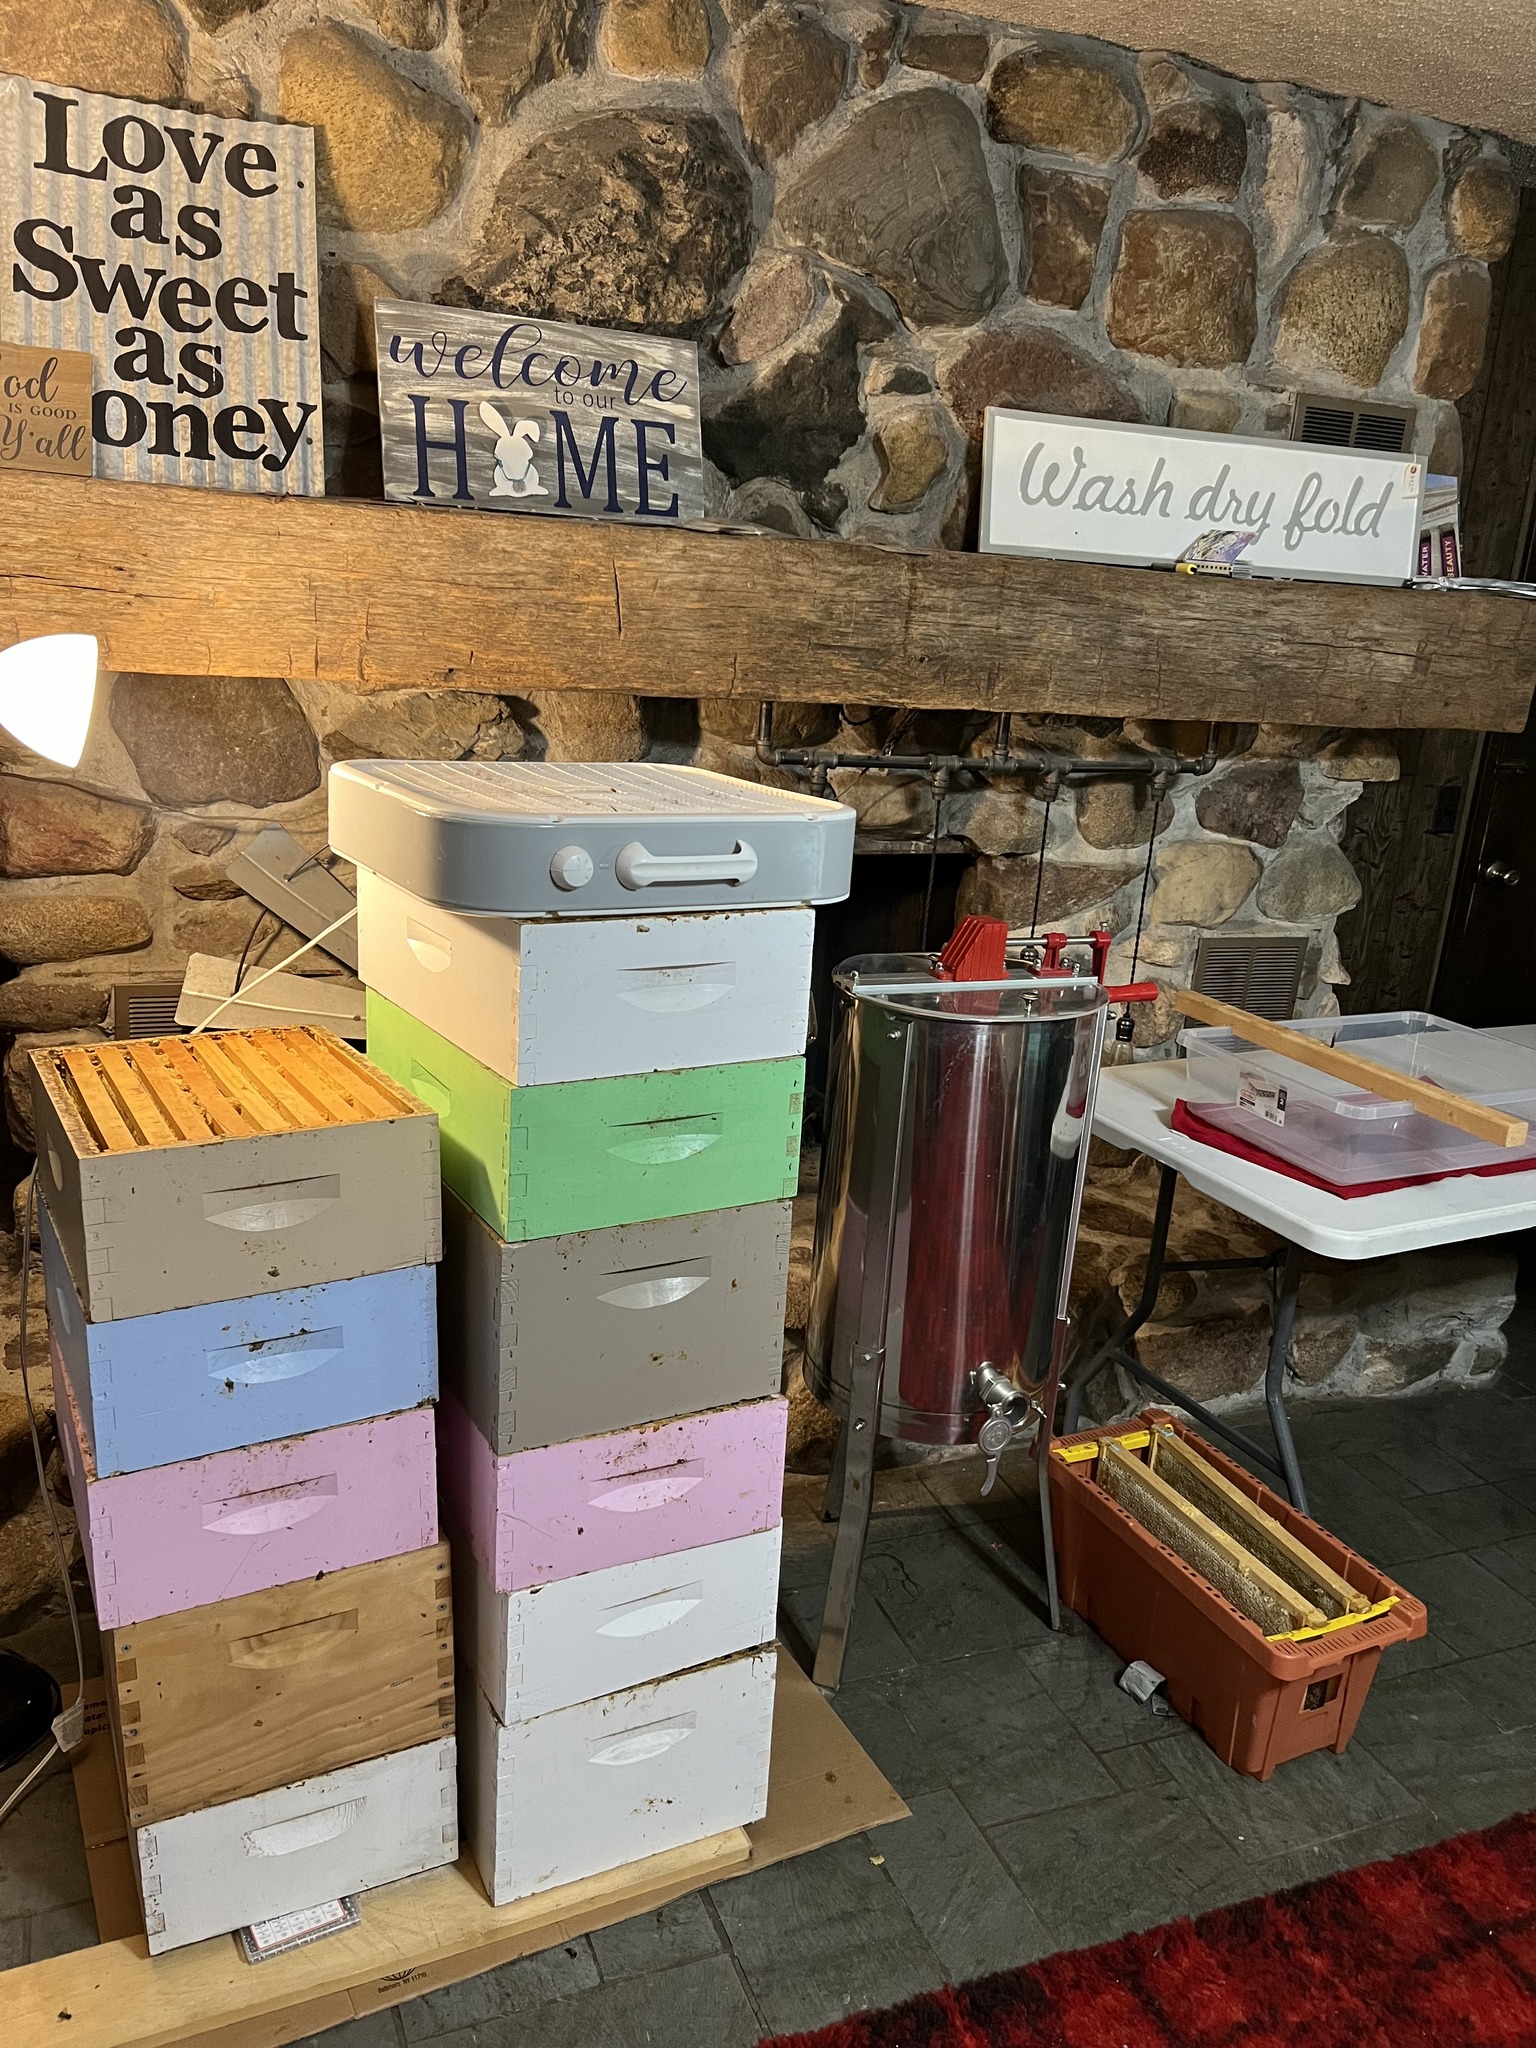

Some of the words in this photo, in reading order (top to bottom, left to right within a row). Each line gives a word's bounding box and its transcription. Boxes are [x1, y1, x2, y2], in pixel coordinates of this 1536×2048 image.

[33, 91, 279, 198] Love
[110, 184, 223, 261] as
[12, 218, 309, 341] Sweet
[2, 356, 59, 403] od
[113, 326, 224, 399] as
[389, 323, 688, 406] welcome
[8, 403, 22, 414] IS
[30, 405, 77, 420] GOOD
[554, 386, 574, 405] to
[582, 391, 616, 410] our
[0, 414, 87, 461] Y'all
[91, 389, 318, 472] oney
[1019, 442, 1174, 518] Wash
[1183, 463, 1276, 545] dry
[1282, 471, 1394, 552] fold
[1446, 540, 1455, 579] BEAUTY
[84, 1723, 110, 1735] opic:
[85, 1712, 105, 1722] ate:
